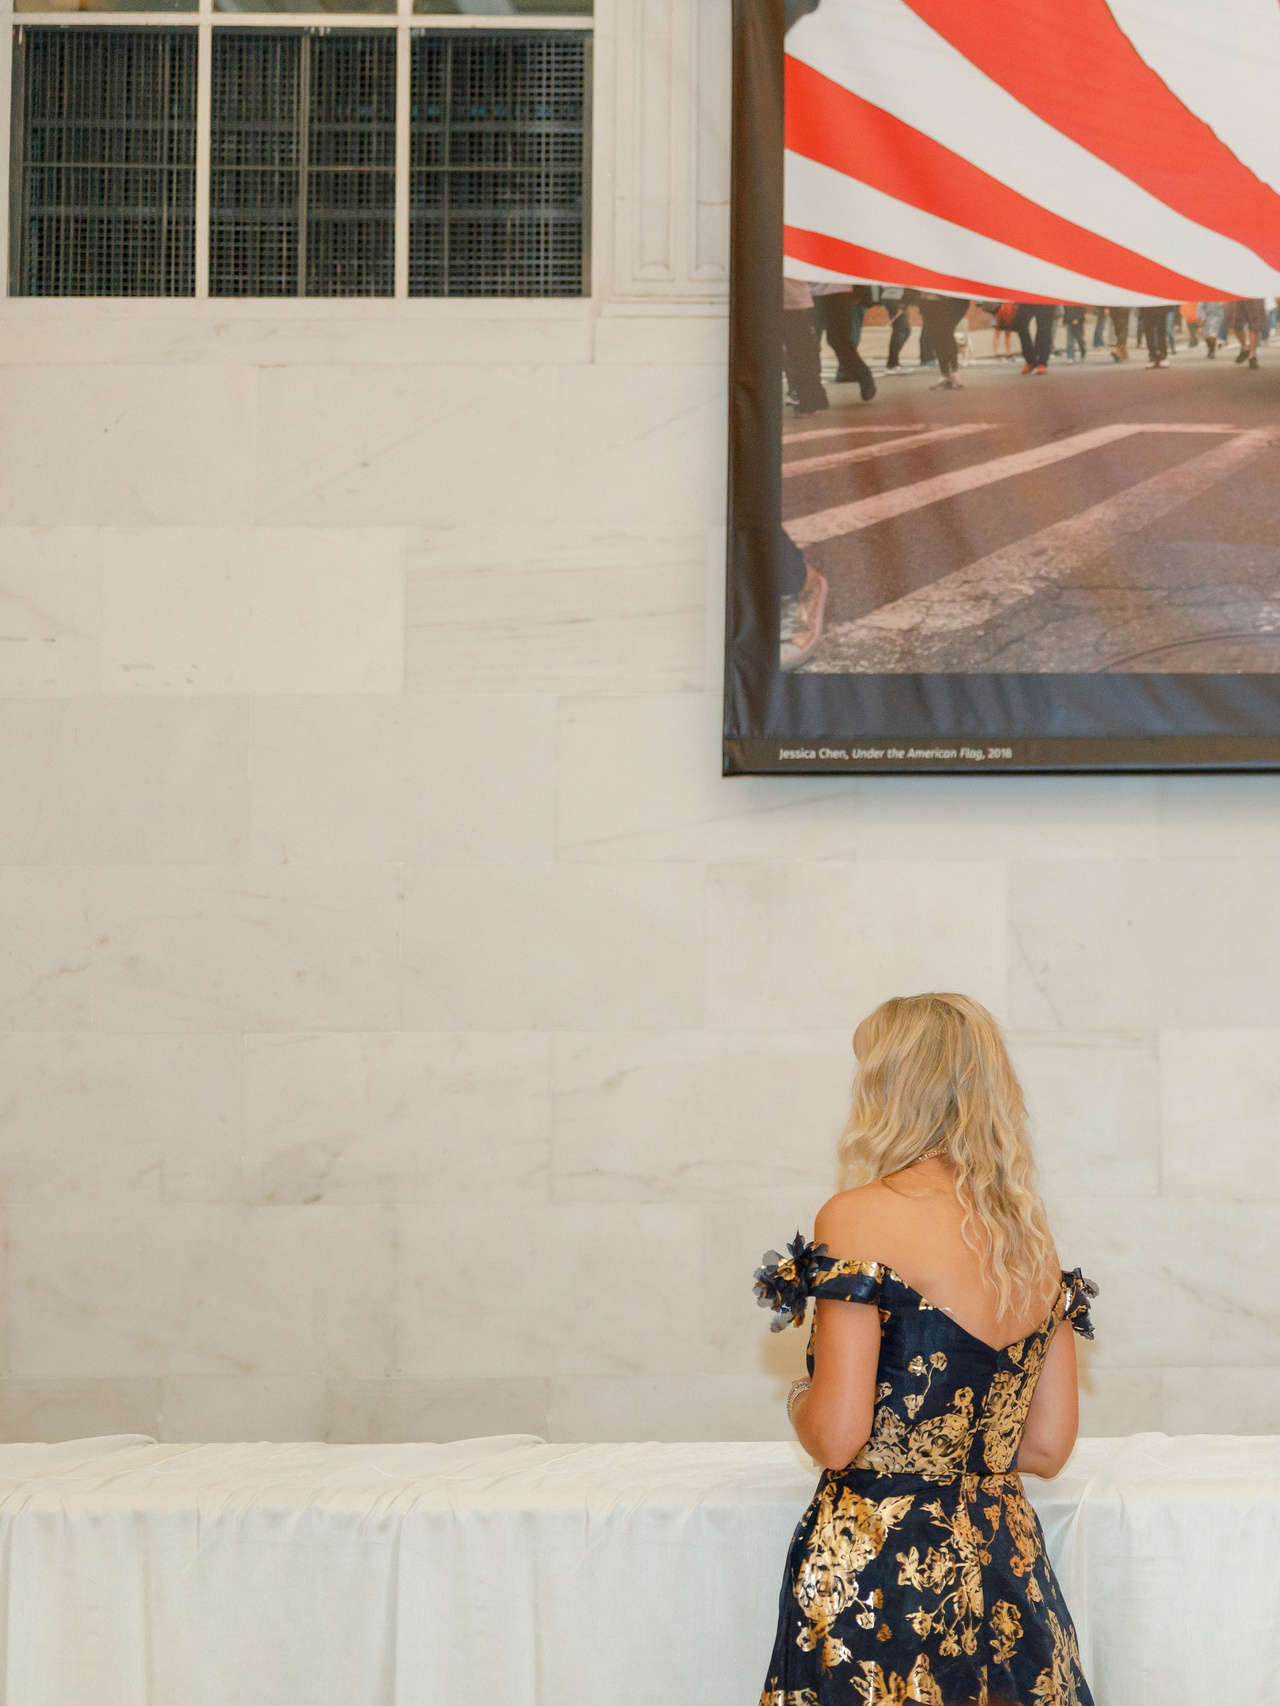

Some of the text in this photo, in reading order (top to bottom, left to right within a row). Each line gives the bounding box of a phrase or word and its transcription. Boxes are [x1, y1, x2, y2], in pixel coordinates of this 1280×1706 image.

[778, 747, 1013, 761] Jessica Chen, Under the American Flag, 2018
